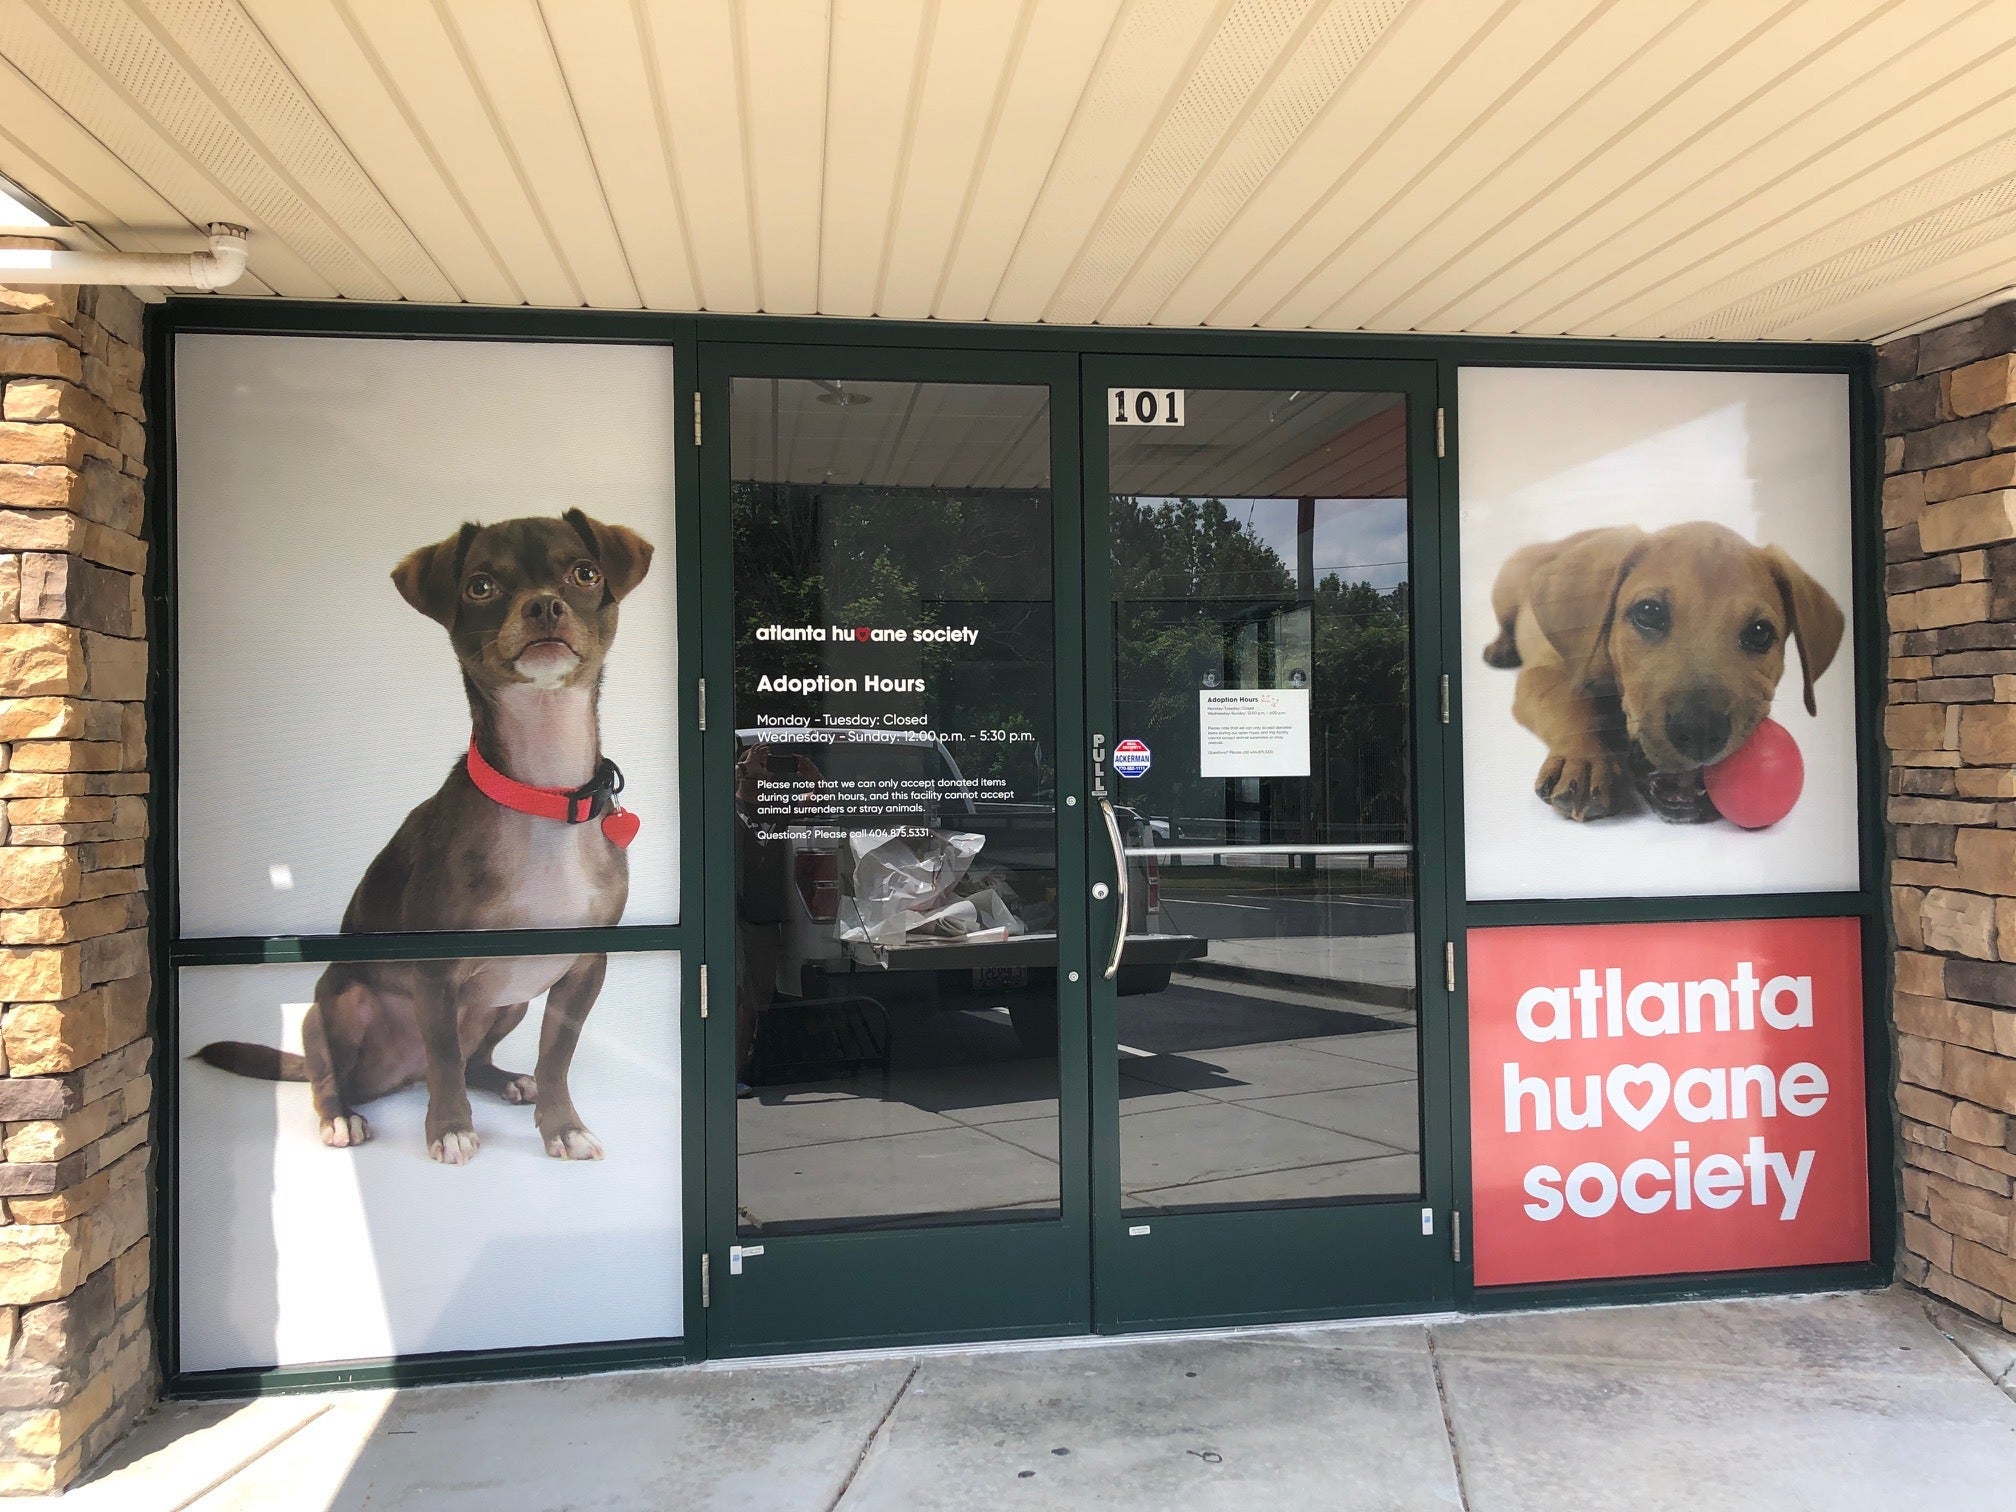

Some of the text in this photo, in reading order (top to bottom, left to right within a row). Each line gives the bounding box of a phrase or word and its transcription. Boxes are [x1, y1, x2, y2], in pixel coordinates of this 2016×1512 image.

[1115, 390, 1178, 423] 101
[755, 624, 826, 641] atlanta
[912, 626, 979, 645] society
[756, 674, 925, 695] Adoption Hours
[757, 713, 811, 728] Monday
[823, 713, 880, 728] Tuesday:
[883, 713, 928, 725] Closed
[757, 730, 836, 745] Wednesday
[847, 730, 900, 744] Sunday:
[903, 730, 937, 742] 12:00
[940, 732, 966, 744] p.m.
[979, 730, 1006, 742] 5:30
[1009, 731, 1035, 744] p.m.
[1092, 734, 1106, 791] PULL
[1115, 755, 1149, 763] ACKERMAN
[757, 780, 790, 789] Please
[792, 780, 815, 789] note
[817, 780, 839, 788] that
[878, 779, 899, 789] only
[900, 779, 935, 789] accept
[937, 778, 979, 787] donated
[980, 778, 1007, 787] items
[757, 793, 789, 803] during
[810, 793, 836, 802] open
[838, 792, 868, 802] hours,
[869, 792, 889, 800] and
[891, 791, 909, 800] this
[910, 790, 943, 801] facility
[944, 791, 979, 799] cannot
[980, 790, 1015, 800] accept
[757, 805, 791, 815] animal
[793, 805, 845, 814] surrenders
[859, 805, 884, 815] stray
[885, 803, 926, 813] animals.
[757, 829, 811, 840] Questions?
[814, 829, 847, 839] Please
[849, 828, 867, 838] call
[1516, 961, 1813, 1043] atlanta
[1523, 1136, 1816, 1221] society
